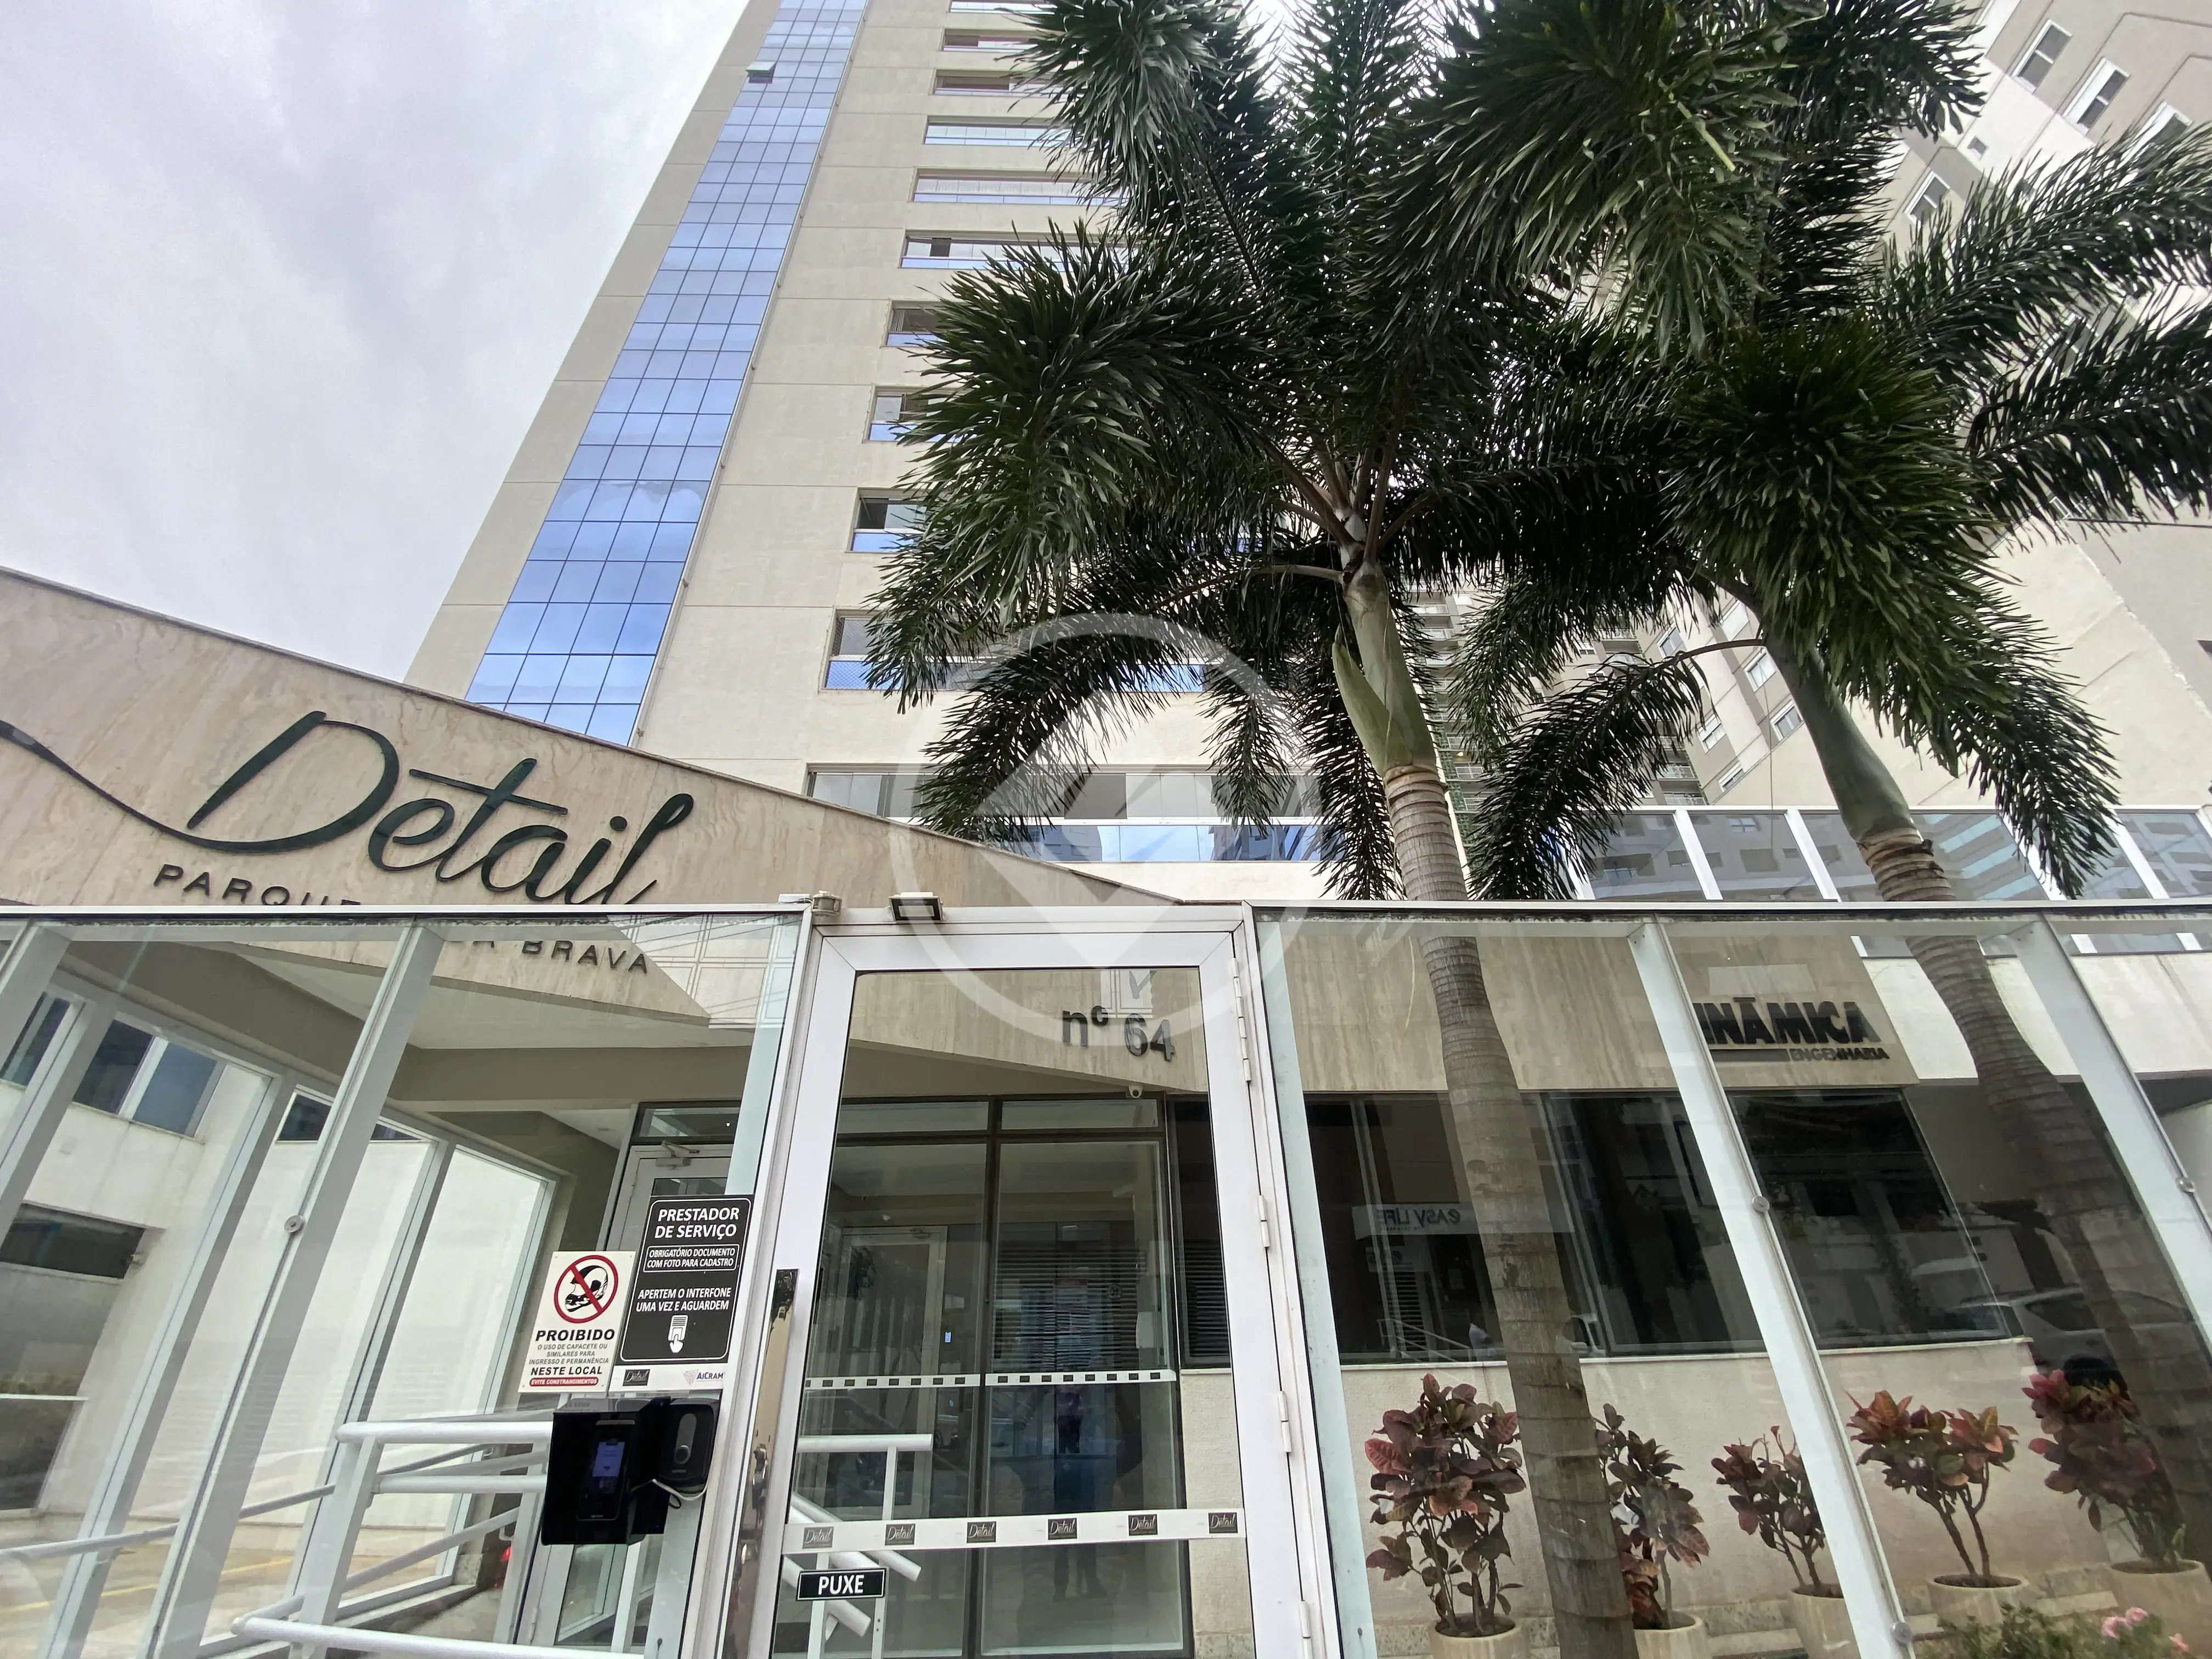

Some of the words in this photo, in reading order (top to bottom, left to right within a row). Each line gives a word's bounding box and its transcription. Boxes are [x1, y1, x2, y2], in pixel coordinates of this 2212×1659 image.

[0, 710, 694, 904] Detail
[154, 864, 362, 905] PARQ
[522, 941, 648, 974] BRAVA
[1124, 1013, 1175, 1062] 64
[1788, 1047, 1890, 1062] ENGENHARIA
[658, 1207, 740, 1222] PRESTADOR
[654, 1226, 674, 1238] DE
[676, 1224, 737, 1240] SERVIÇO
[649, 1247, 692, 1258] OBRIGATÓRIO
[693, 1248, 735, 1257] DOCUMENTO
[647, 1260, 663, 1268] COM
[663, 1259, 681, 1267] FOTO
[681, 1259, 698, 1267] PARA
[699, 1258, 734, 1267] CADASTRO
[637, 1289, 676, 1299] APERTEM
[678, 1288, 685, 1299] O
[686, 1287, 732, 1298] INTERFONE
[636, 1302, 656, 1312] UMA
[658, 1301, 674, 1311] VEZ
[674, 1301, 680, 1311] E
[680, 1300, 730, 1311] AGUARDEM
[535, 1329, 615, 1341] PROIBIDO
[531, 1367, 566, 1376] NESTE
[568, 1366, 602, 1375] LOCAL
[625, 1369, 649, 1383] Detail
[1049, 1519, 1076, 1535] Detail
[1130, 1515, 1156, 1531] Detail
[1210, 1513, 1237, 1529] Detail
[805, 1528, 832, 1545] Detail
[887, 1524, 915, 1541] Detail
[968, 1522, 995, 1538] Detail
[818, 1574, 865, 1595] PUXE
